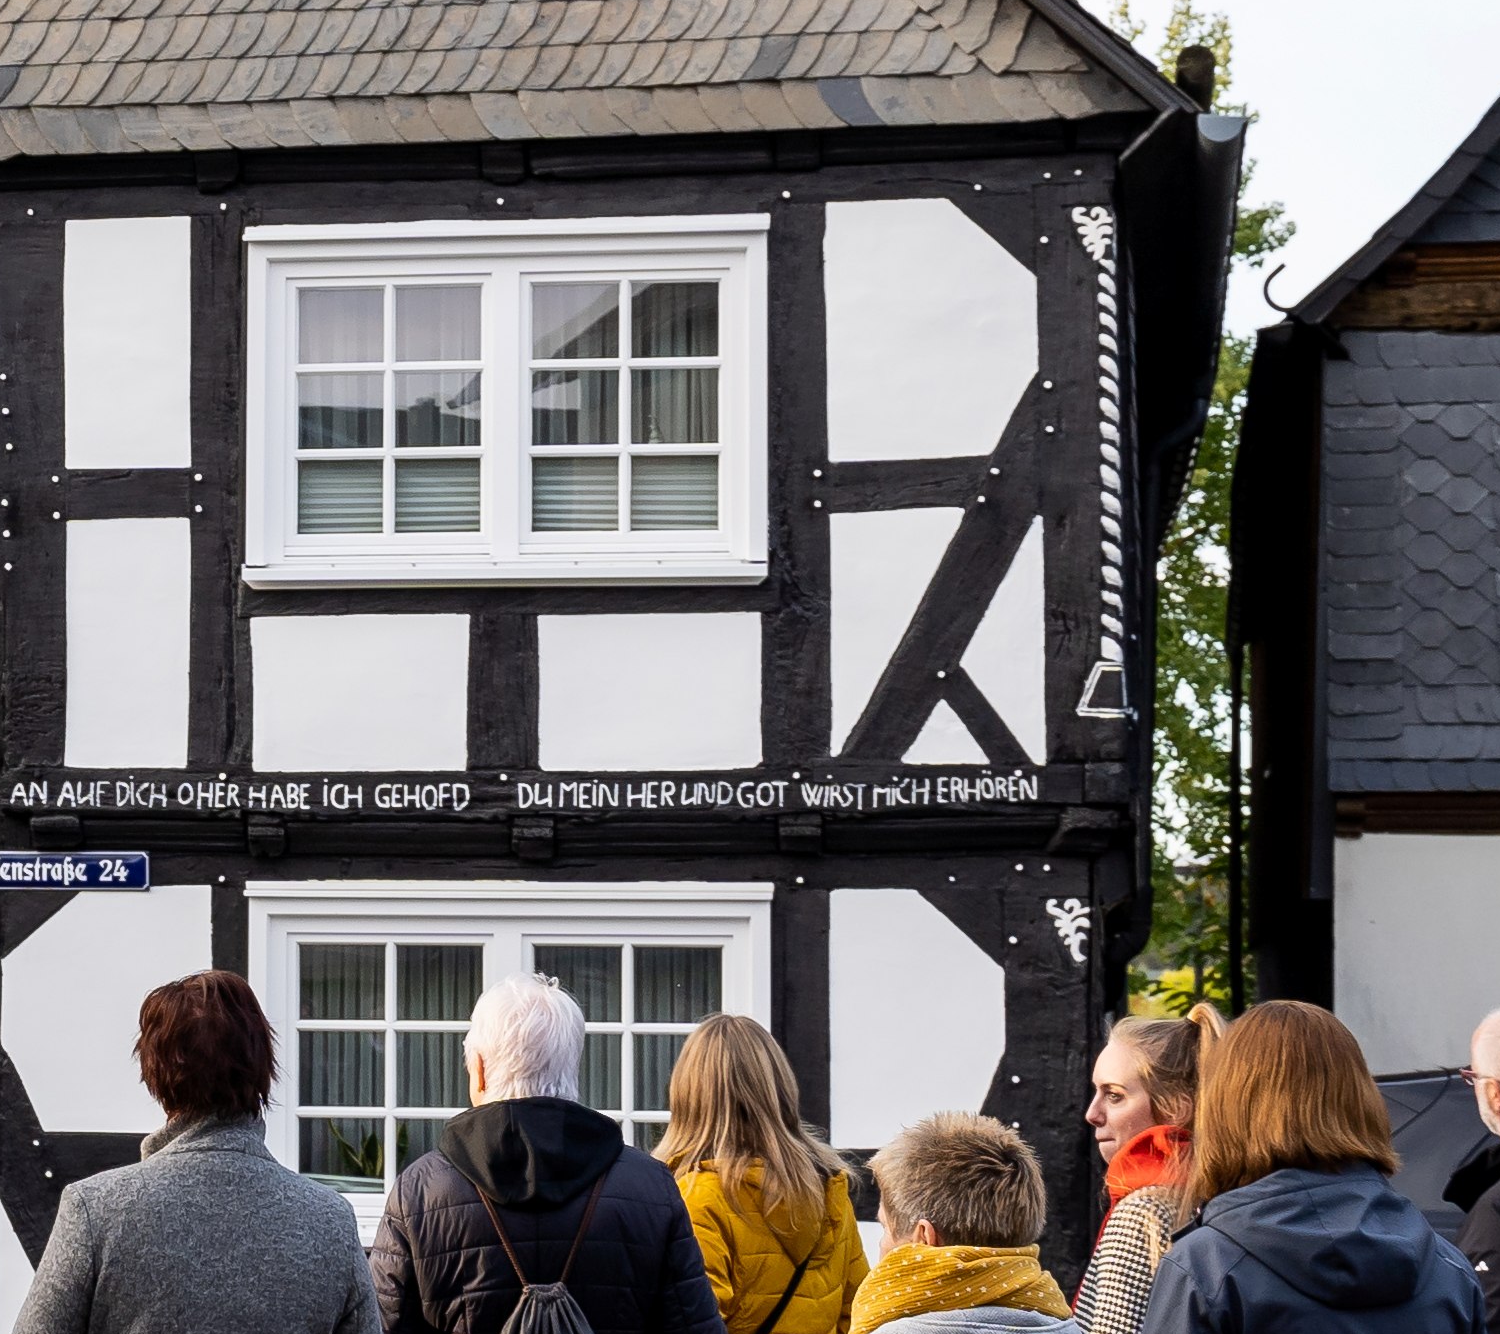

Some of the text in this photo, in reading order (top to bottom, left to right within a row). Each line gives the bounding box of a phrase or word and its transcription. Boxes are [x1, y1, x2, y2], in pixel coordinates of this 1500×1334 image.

[10, 781, 48, 807] AN
[57, 781, 110, 808] AUF
[248, 783, 311, 810] HABE
[517, 782, 553, 809] DU
[626, 782, 676, 809] HER
[681, 782, 733, 806] UND
[736, 781, 790, 808] GOT
[99, 859, 129, 882] 24
